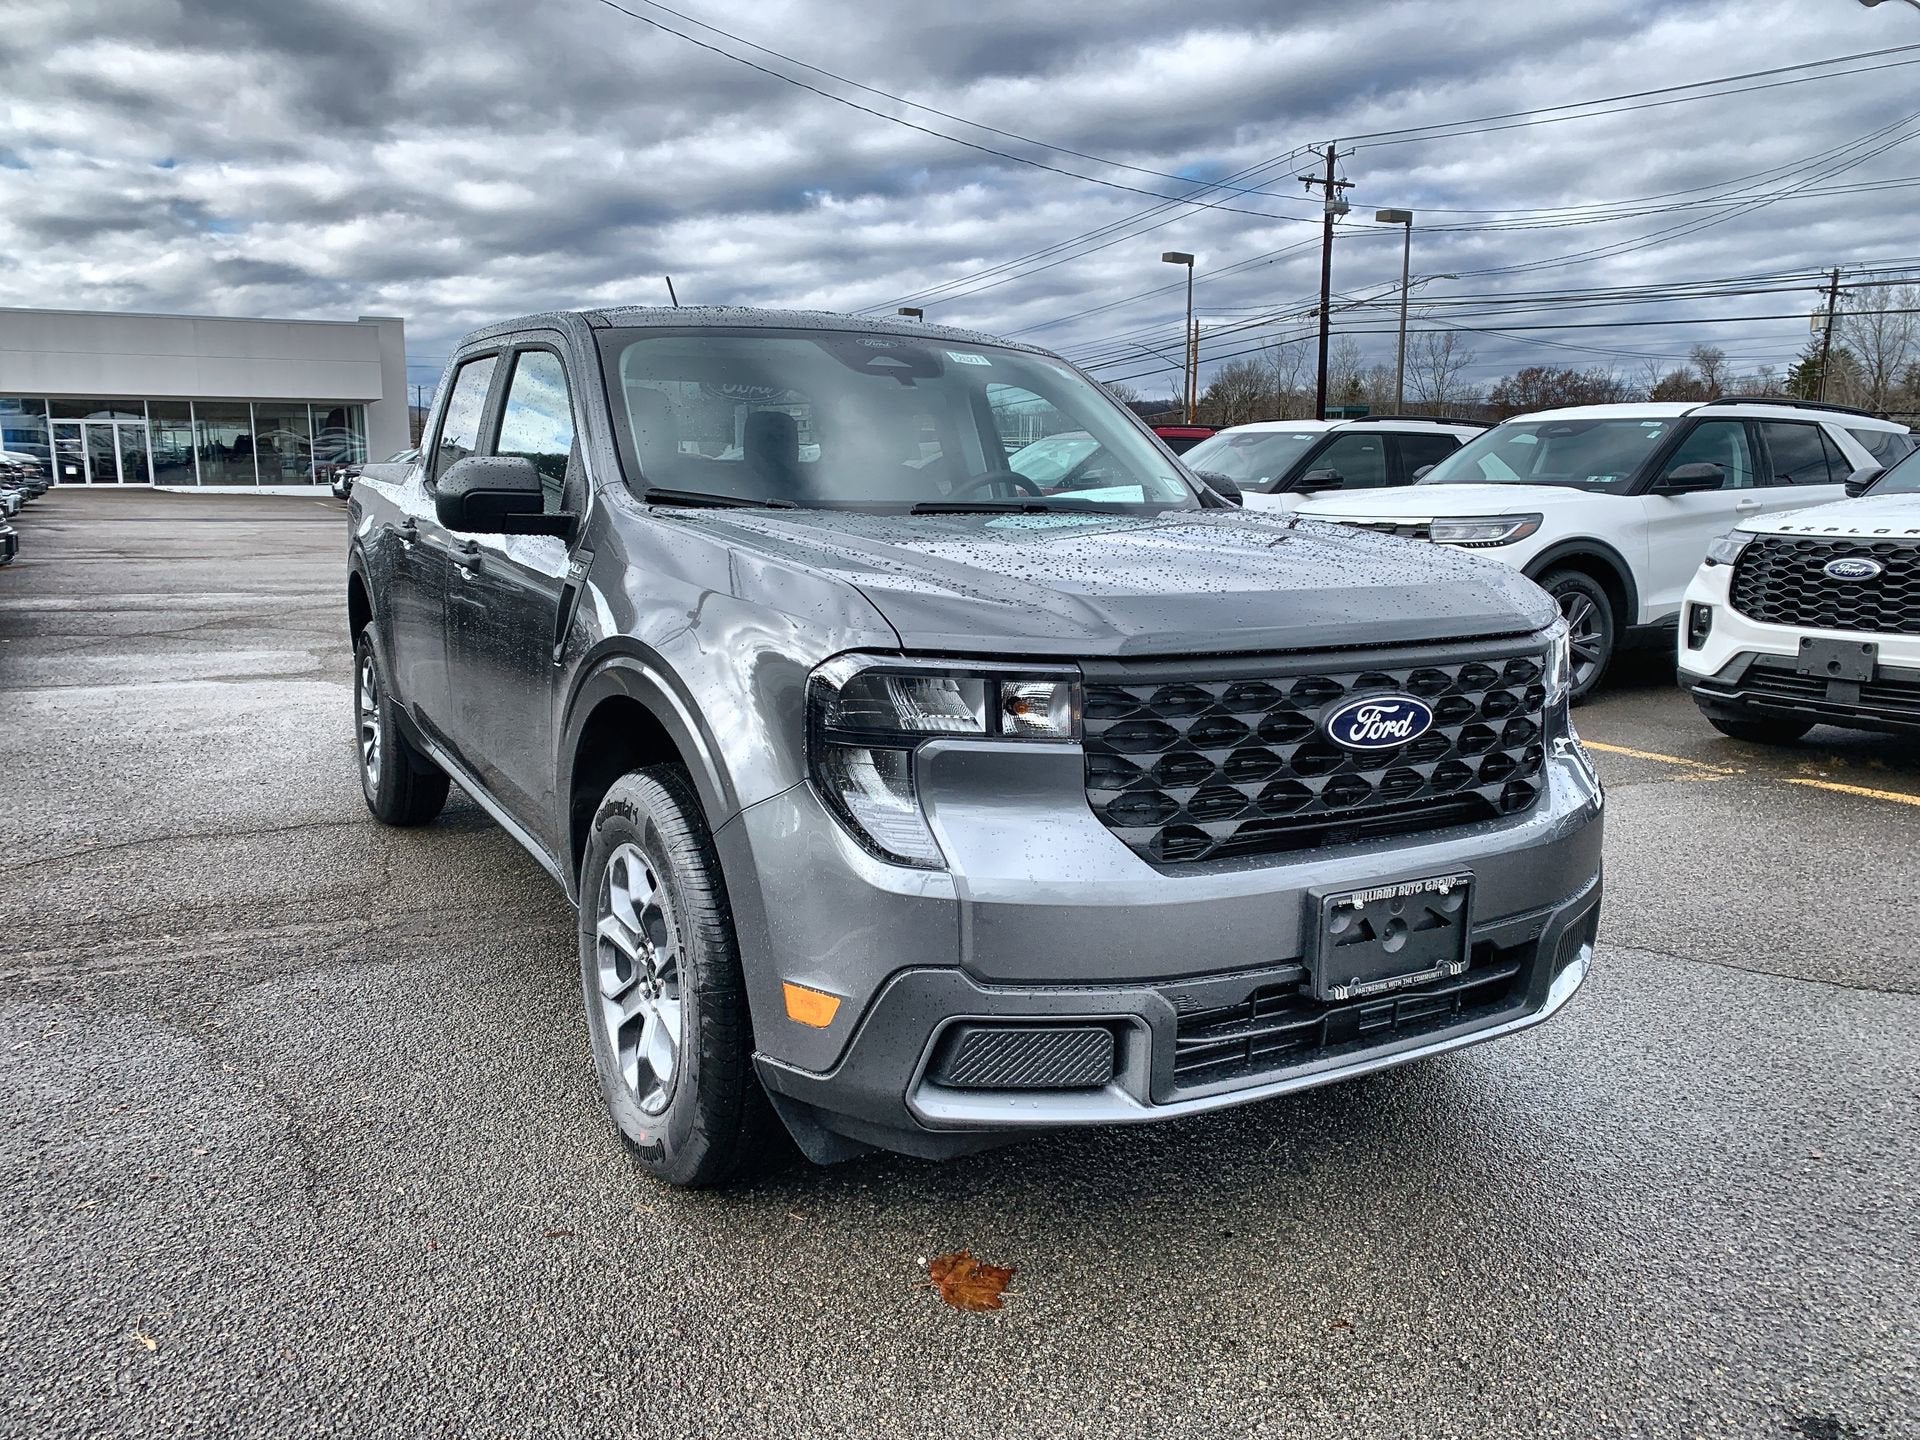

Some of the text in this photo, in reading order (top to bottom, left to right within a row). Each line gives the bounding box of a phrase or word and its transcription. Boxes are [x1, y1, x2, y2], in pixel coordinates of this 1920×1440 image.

[1778, 525, 1920, 535] EXPLOR
[1834, 562, 1867, 576] Ford
[1350, 704, 1415, 741] Ford
[1398, 882, 1424, 896] AUTO
[1389, 979, 1403, 989] WITH
[1403, 976, 1413, 986] THE
[1414, 970, 1444, 983] COMMUNITY
